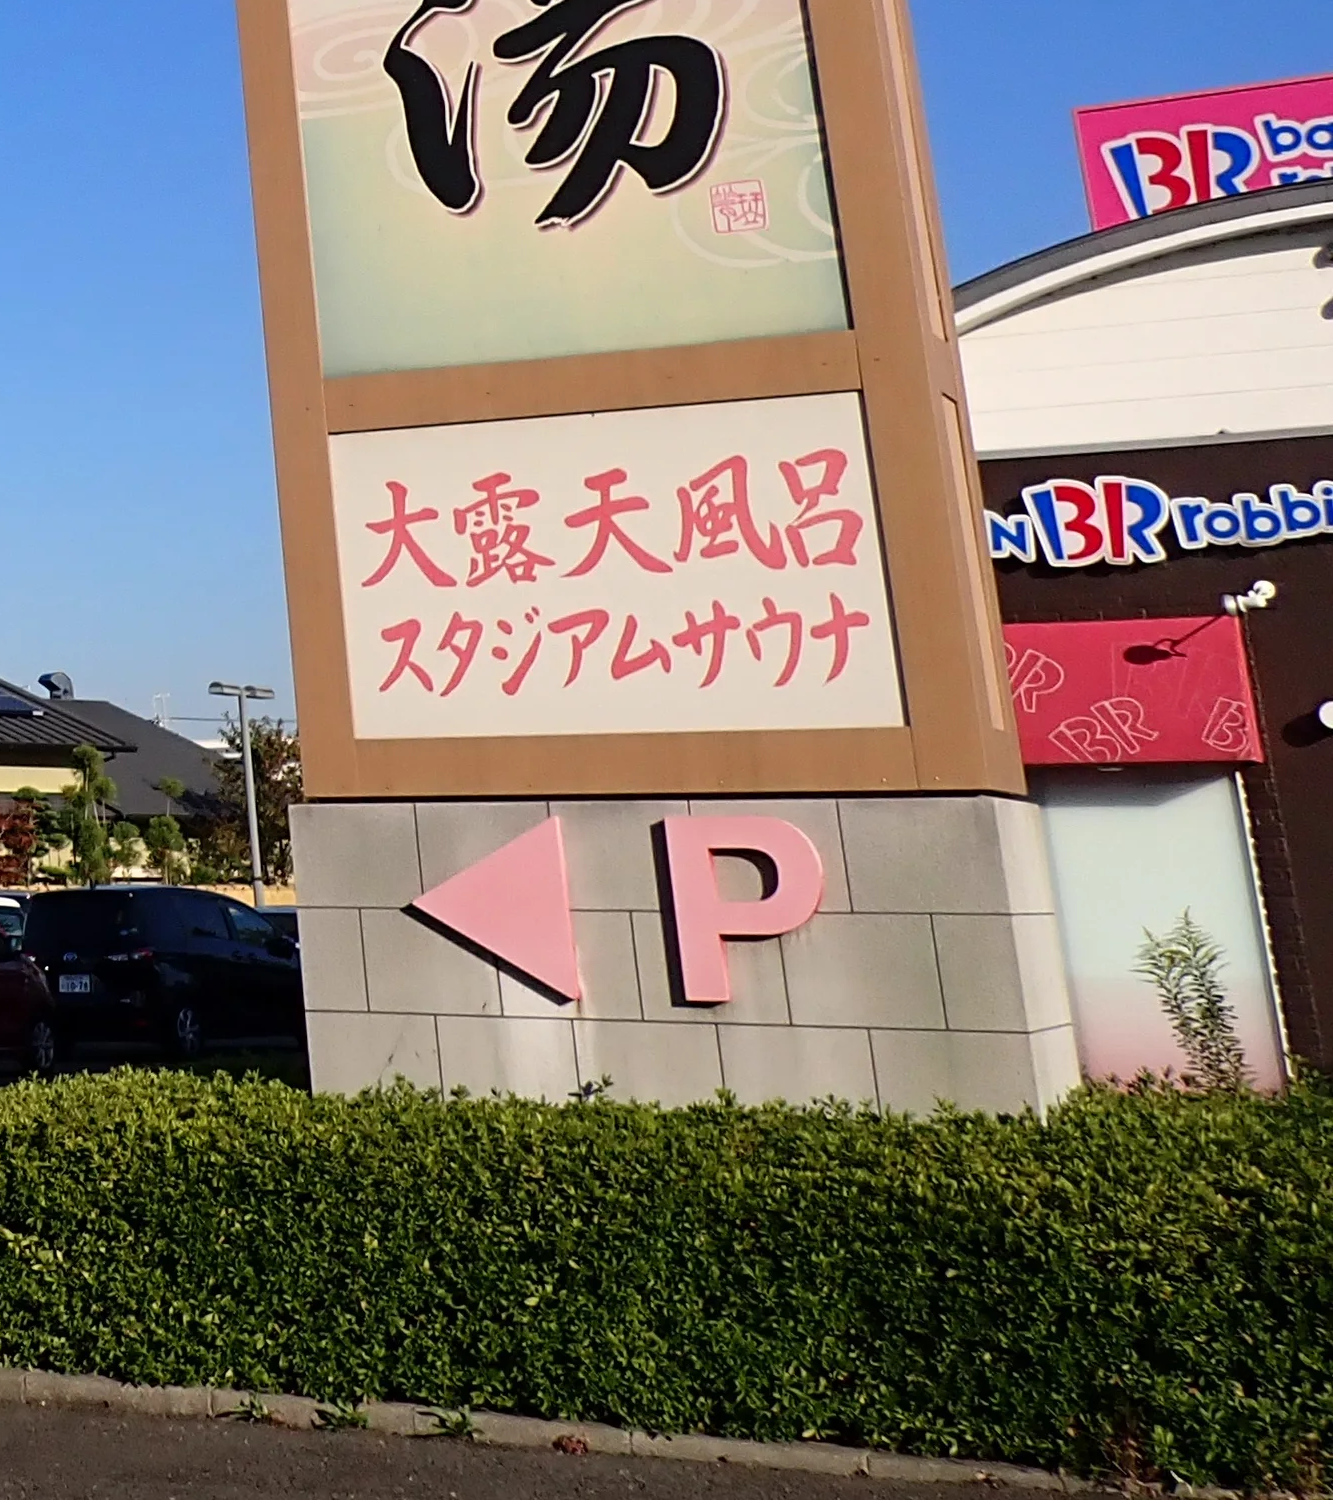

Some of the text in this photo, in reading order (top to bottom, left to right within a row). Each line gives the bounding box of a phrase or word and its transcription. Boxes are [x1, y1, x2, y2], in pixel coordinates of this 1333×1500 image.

[361, 448, 863, 588] 大露天風呂
[1029, 481, 1164, 561] BR
[379, 592, 870, 696] スタジアムサウナ
[661, 816, 824, 1003] P
